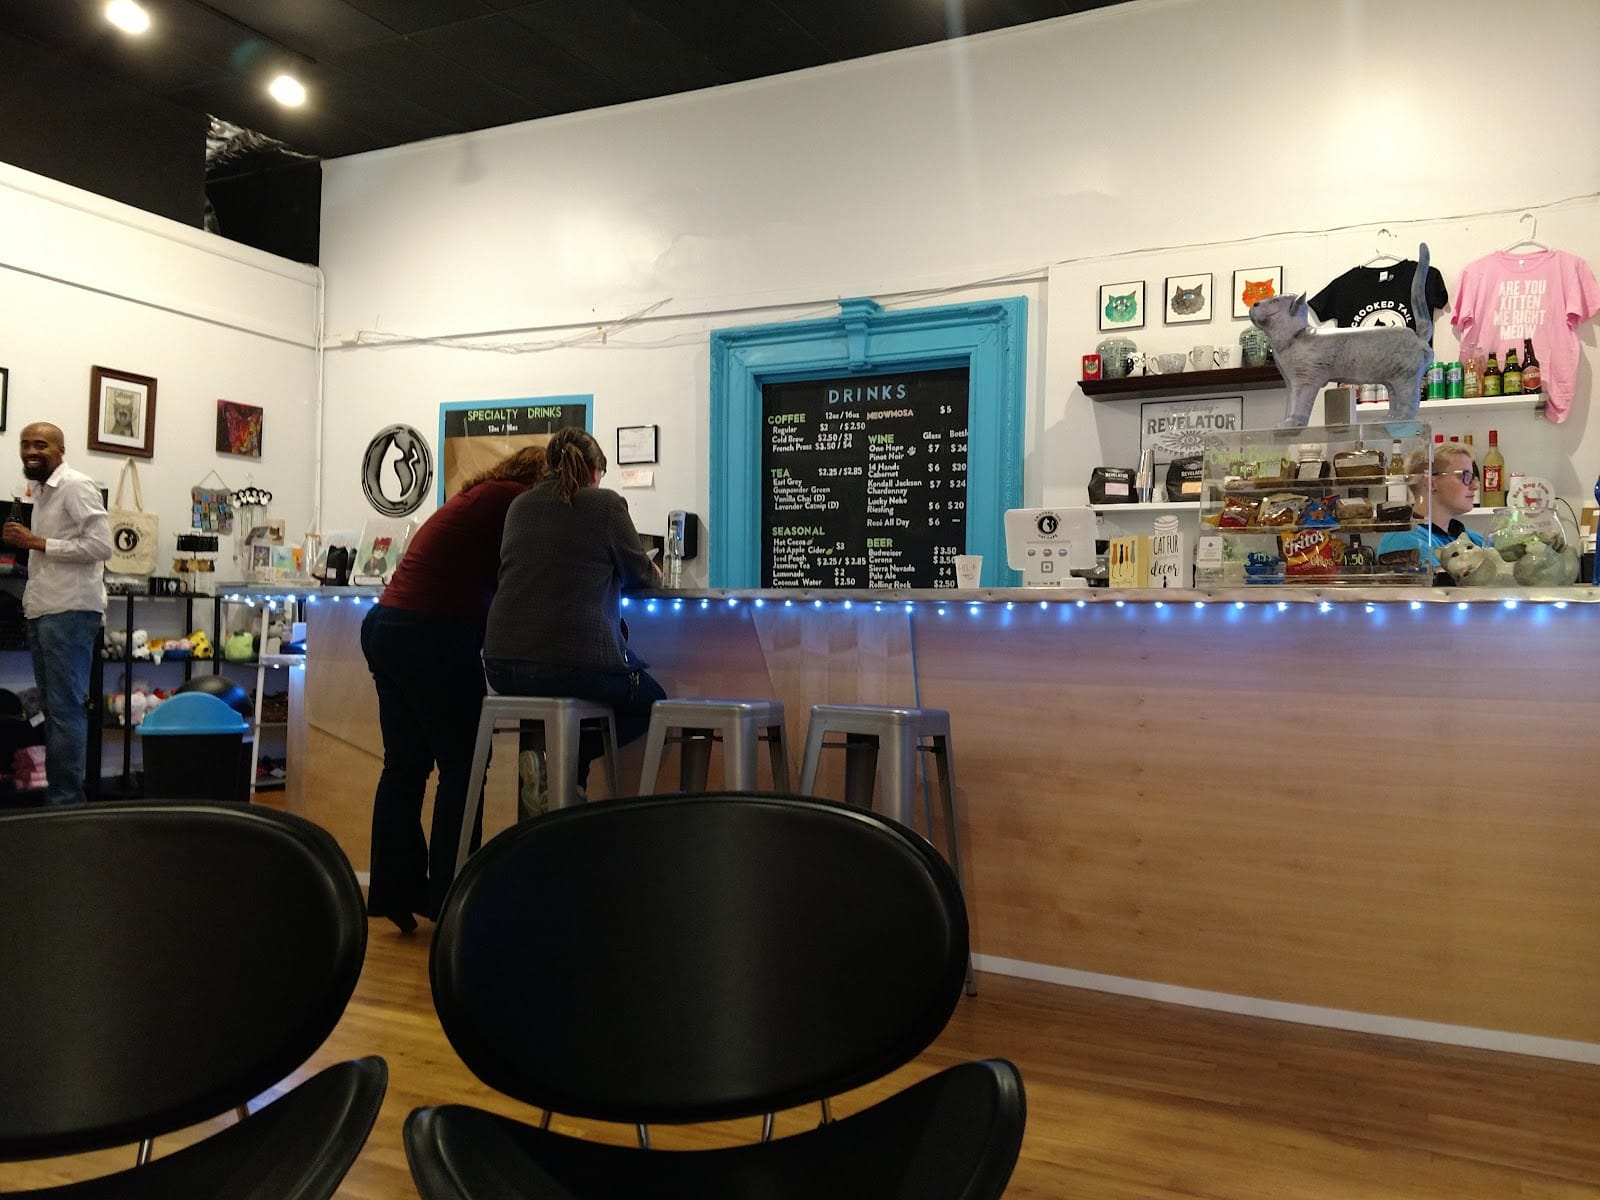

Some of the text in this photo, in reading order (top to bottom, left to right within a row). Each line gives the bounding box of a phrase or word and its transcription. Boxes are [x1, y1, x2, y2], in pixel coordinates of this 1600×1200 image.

[1499, 280, 1546, 296] ARE YOU
[1500, 295, 1541, 311] KITTEN
[1351, 300, 1412, 328] CROOKED TAIL
[1493, 310, 1546, 326] ME RIGHT
[1500, 324, 1536, 341] MEOW
[828, 384, 906, 404] DRINKS
[468, 406, 562, 421] SPECIALTY DRINKS
[940, 405, 952, 414] $5
[768, 413, 806, 425] COFFEE
[866, 409, 914, 420] MEOWMOSA
[820, 423, 828, 432] $2
[1148, 413, 1236, 434] REVELATOR
[773, 426, 797, 436] Regular
[949, 429, 968, 438] Bottl
[772, 435, 787, 443] Cold
[868, 434, 894, 444] WINE
[773, 444, 794, 452] French
[886, 444, 904, 453] Hope
[928, 444, 967, 453] $7 $24
[888, 452, 904, 460] Noir
[878, 463, 899, 471] Hands
[928, 463, 967, 472] $6 $20
[771, 468, 790, 478] TEA
[787, 478, 802, 487] Grey
[868, 480, 893, 488] Kendall
[929, 480, 966, 489] $7 $24
[773, 487, 808, 496] Gunpowder
[867, 487, 908, 497] Chardonnay
[774, 495, 795, 503] Vanilla
[813, 494, 825, 502] (D)
[868, 497, 888, 507] Lucky
[805, 502, 826, 512] Catnip
[828, 501, 839, 510] (D)
[928, 501, 964, 511] $6 $20
[867, 506, 894, 516] Riesling
[884, 518, 894, 526] All
[896, 518, 910, 528] Day
[928, 518, 940, 526] $6
[772, 527, 825, 536] SEASONAL
[867, 538, 893, 548] BEER
[1153, 534, 1178, 555] CAT FUR
[786, 546, 805, 555] Apple
[834, 568, 845, 576] $2
[939, 568, 951, 576] $4
[869, 580, 892, 589] Rolling
